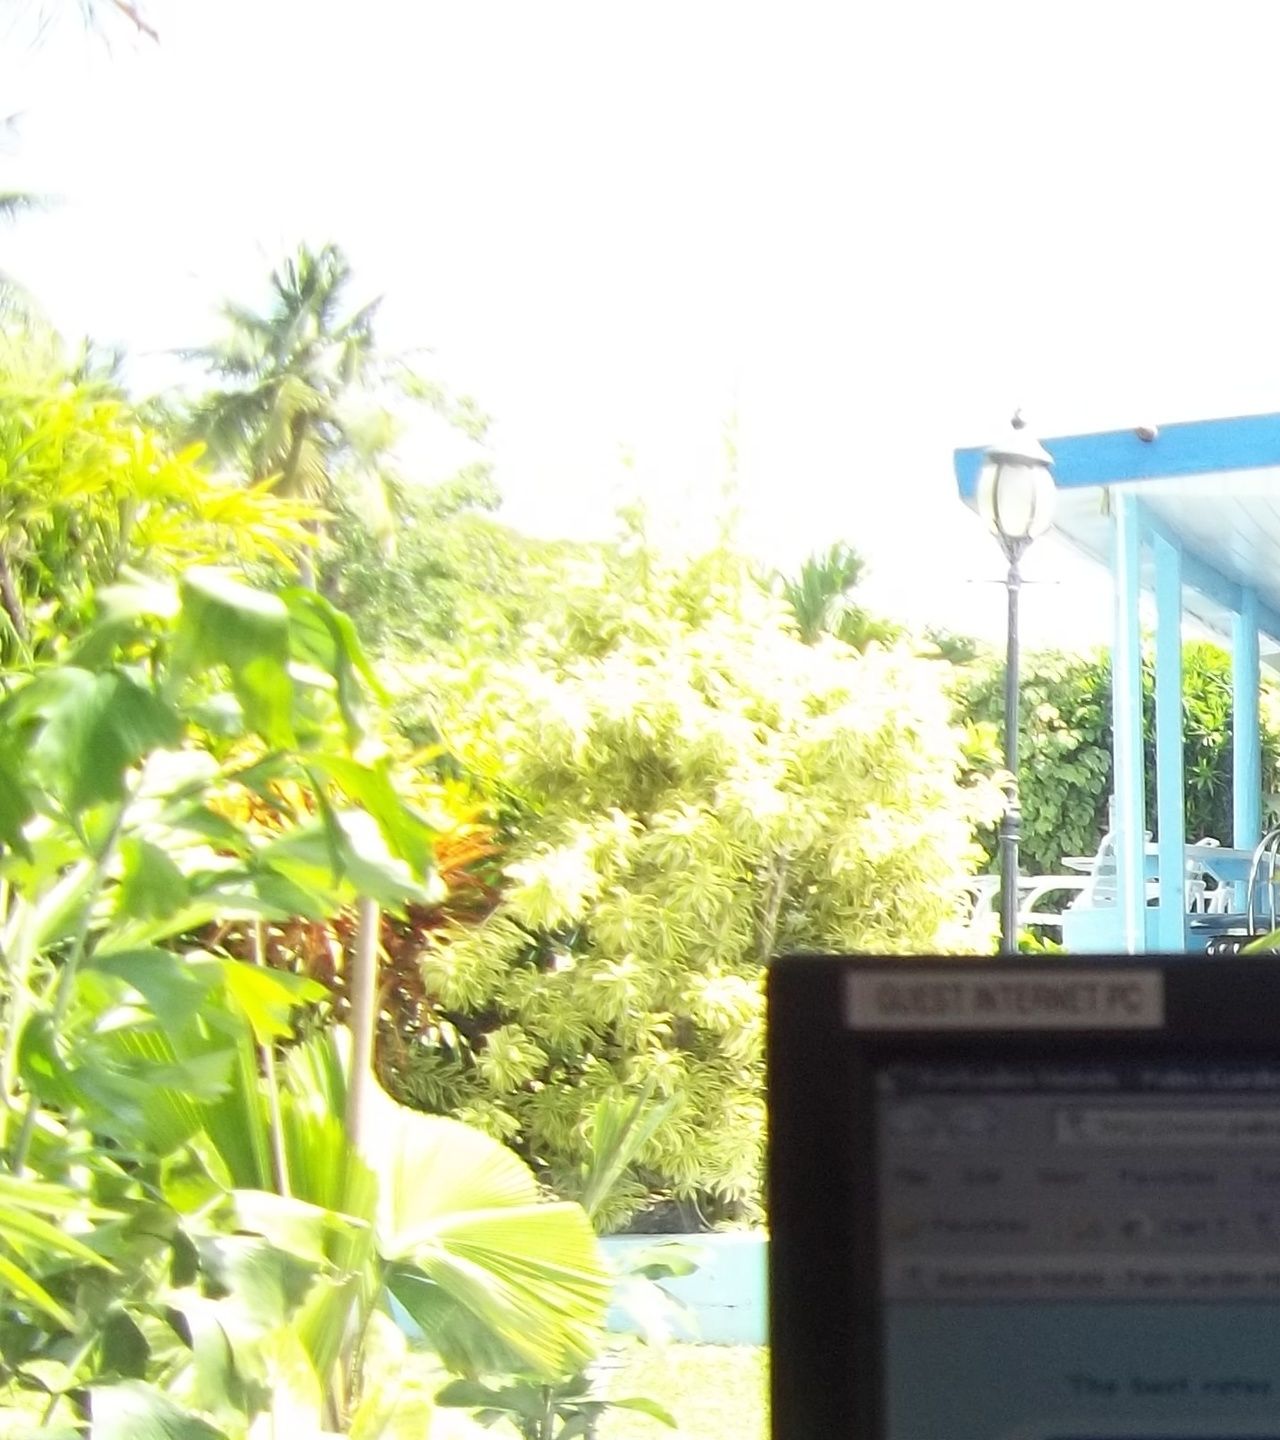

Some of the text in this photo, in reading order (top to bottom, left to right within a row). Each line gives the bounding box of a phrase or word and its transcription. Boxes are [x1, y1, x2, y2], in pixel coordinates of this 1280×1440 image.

[877, 981, 1143, 1015] GUEST INTERNET PC
